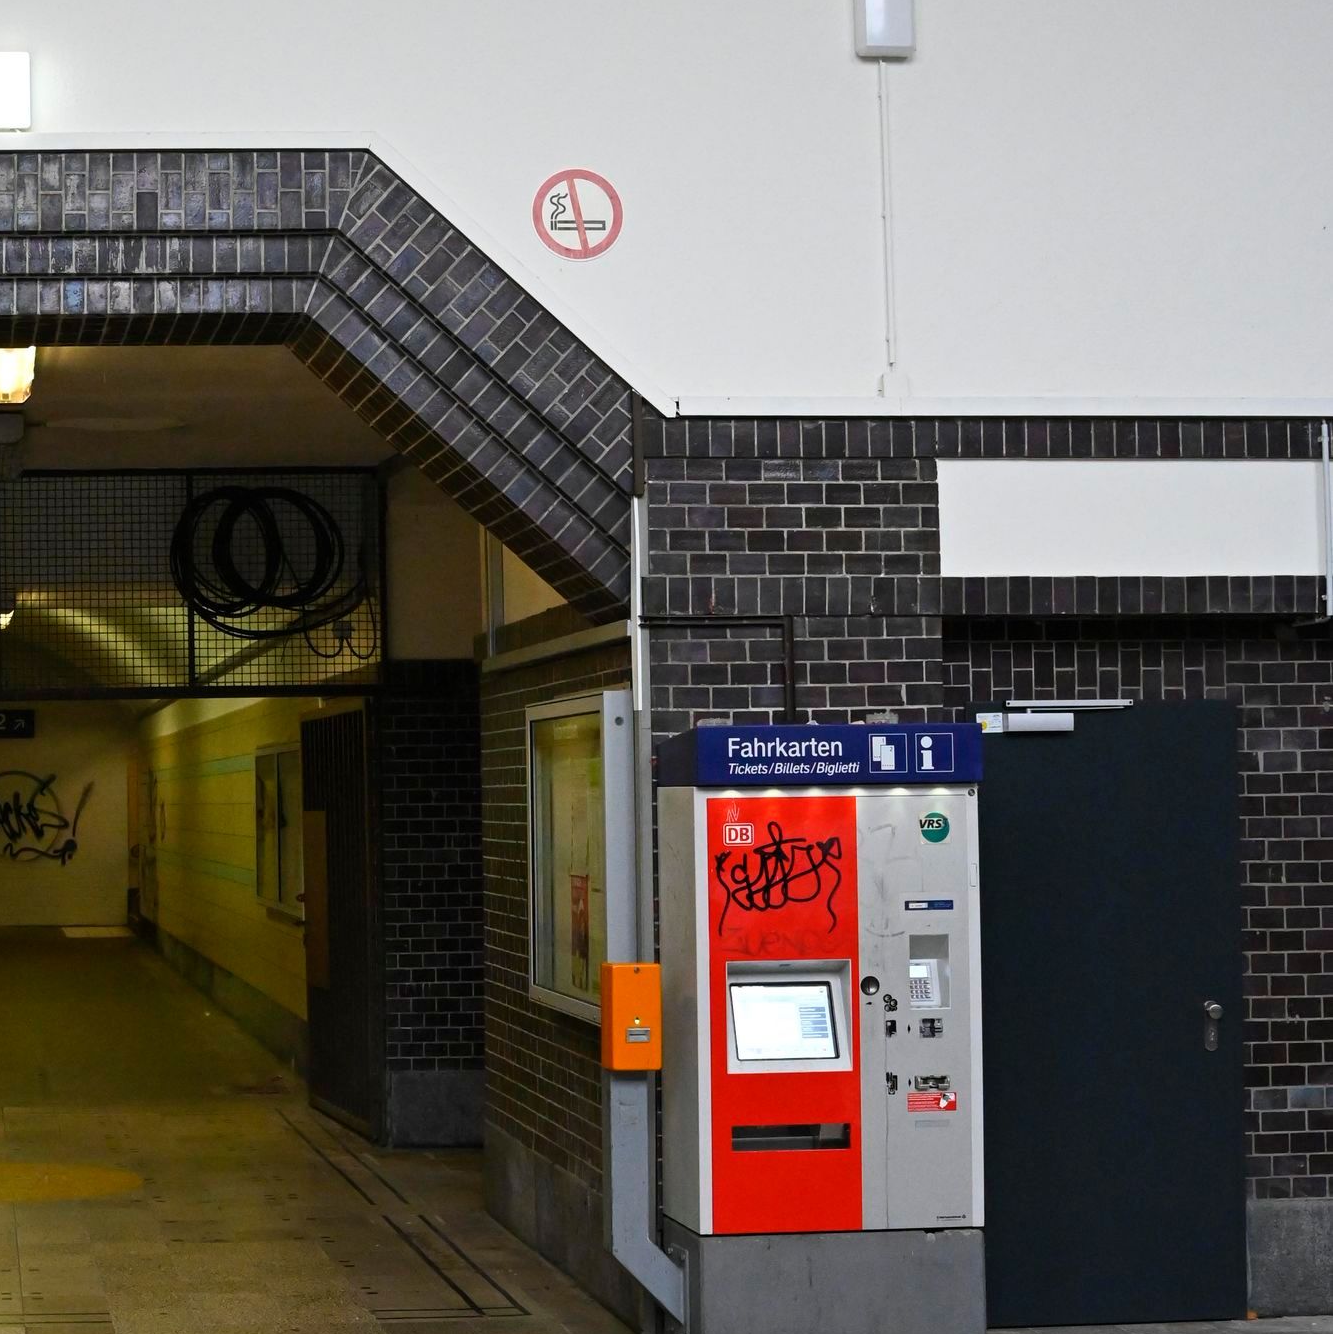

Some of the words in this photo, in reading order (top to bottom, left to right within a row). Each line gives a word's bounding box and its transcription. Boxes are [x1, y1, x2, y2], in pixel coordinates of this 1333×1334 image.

[728, 737, 843, 758] Fahrkarten
[919, 819, 942, 829] VRS
[726, 826, 751, 843] DB
